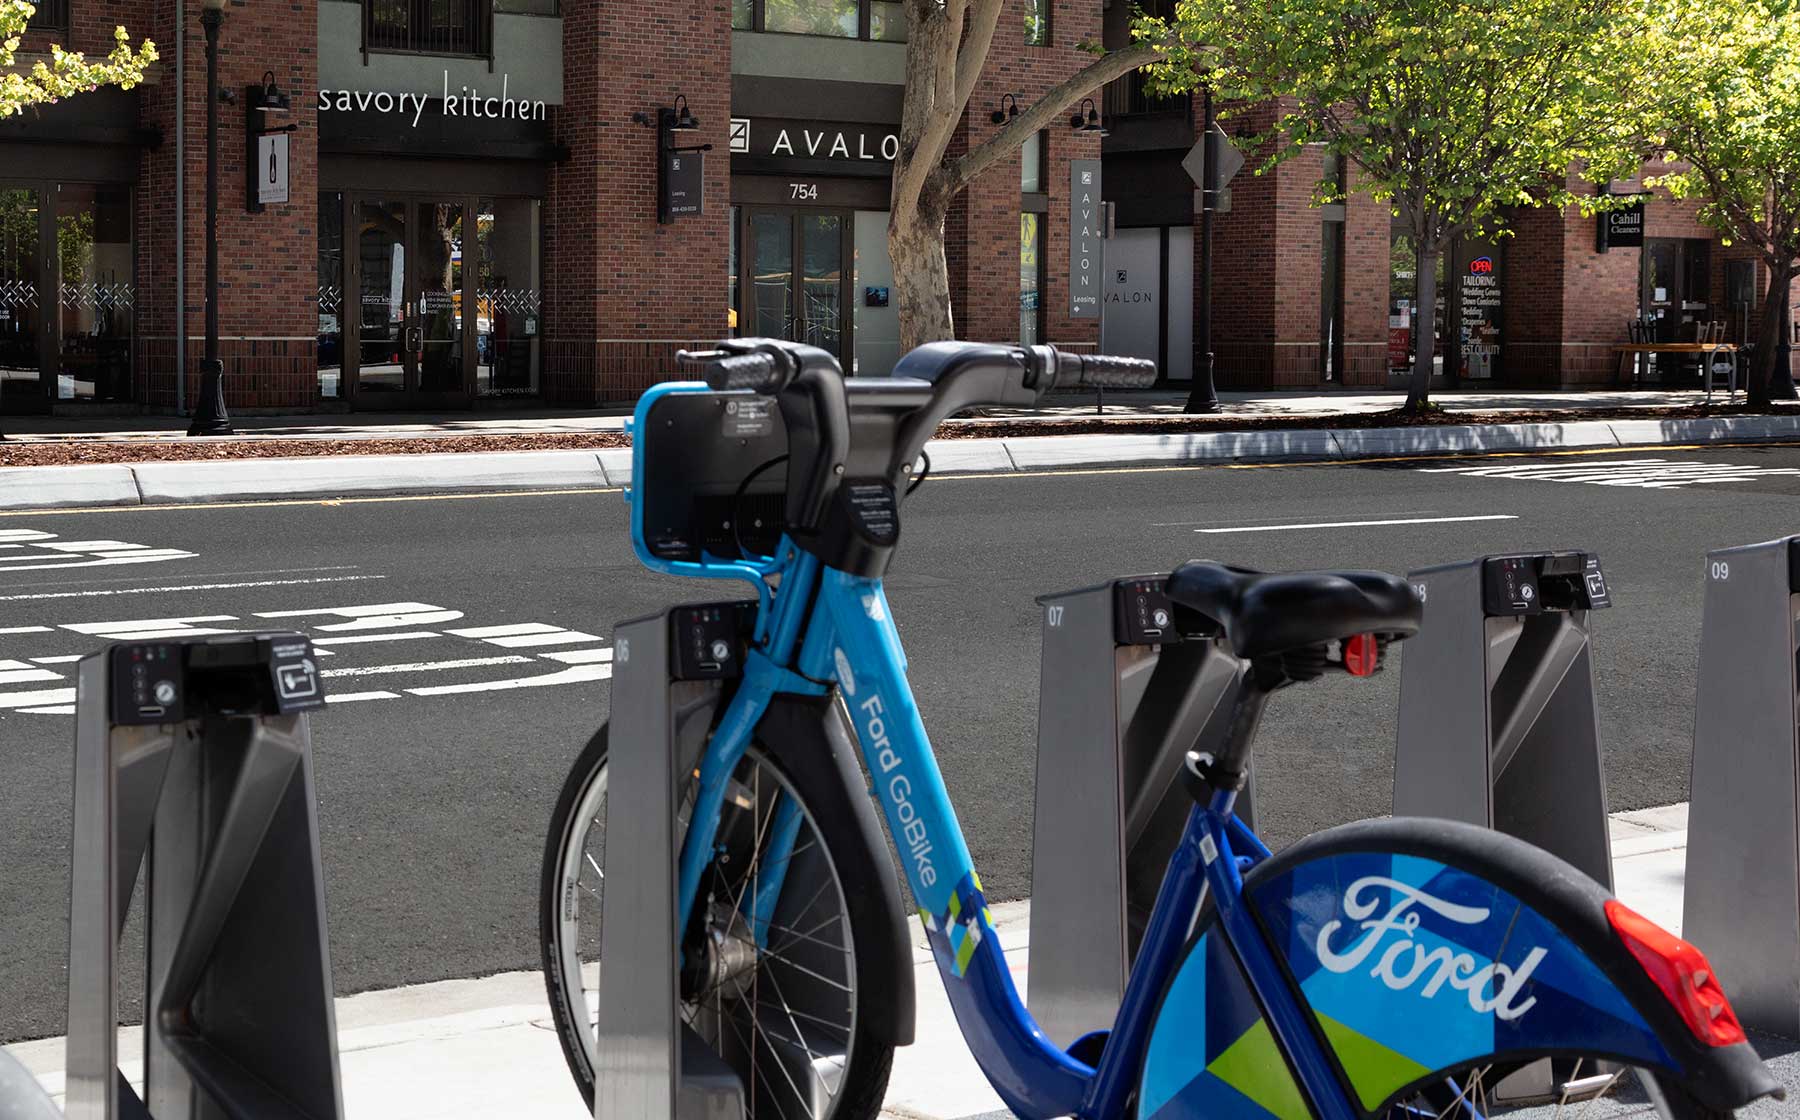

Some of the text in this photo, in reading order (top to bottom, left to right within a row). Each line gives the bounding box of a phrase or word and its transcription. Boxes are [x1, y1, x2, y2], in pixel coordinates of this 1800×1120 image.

[318, 70, 545, 127] savory kitchen
[790, 183, 818, 200] 754
[1610, 212, 1640, 225] Cahill
[1610, 225, 1640, 234] Cleaners
[1081, 193, 1090, 286] AVALON
[1470, 260, 1493, 273] OPEN
[1462, 275, 1496, 287] TAILORING
[1073, 295, 1096, 304] Leasing
[1711, 562, 1729, 580] 09
[1048, 605, 1064, 627] 07
[616, 639, 630, 662] 06
[861, 695, 938, 889] Ford GoBike
[1316, 876, 1548, 1021] Ford
